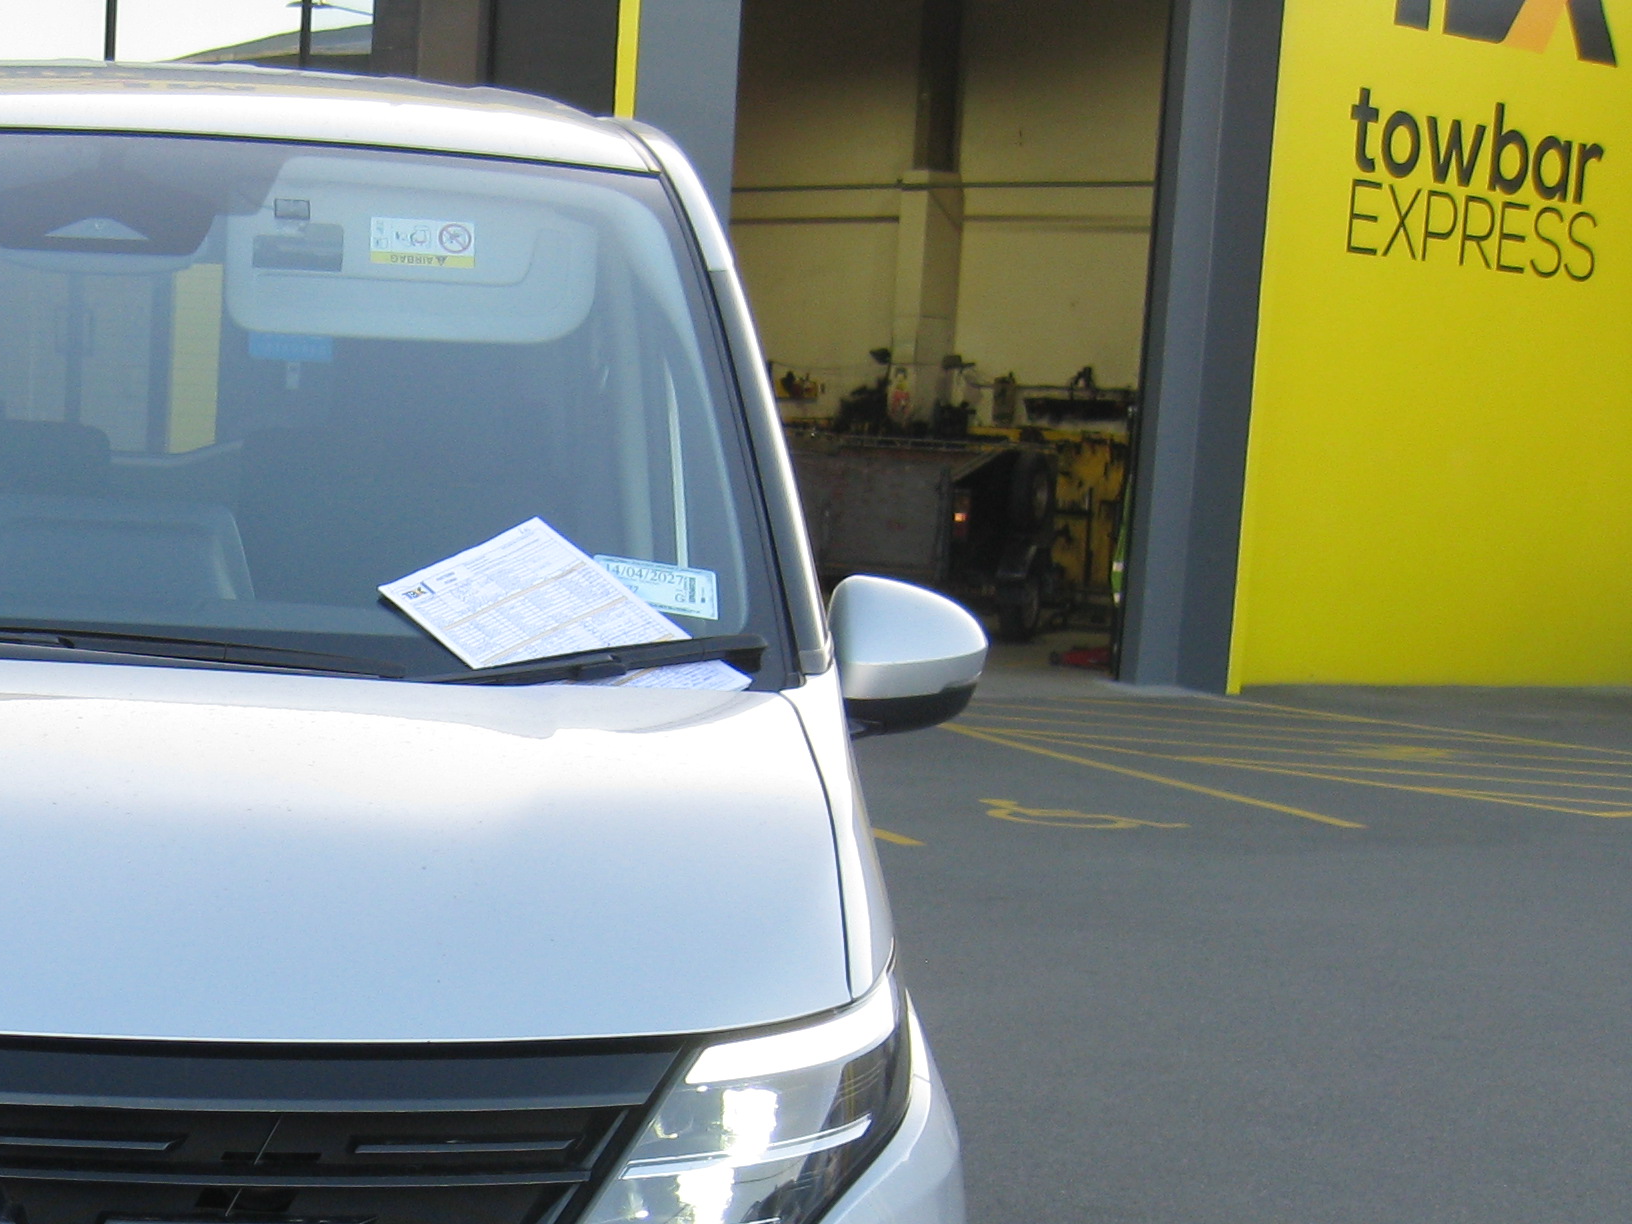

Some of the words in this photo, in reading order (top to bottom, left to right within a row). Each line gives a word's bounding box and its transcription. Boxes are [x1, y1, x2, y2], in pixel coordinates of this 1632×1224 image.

[1350, 86, 1604, 204] towbar
[390, 254, 434, 265] AIRBAG
[1346, 178, 1599, 282] EXPRESS
